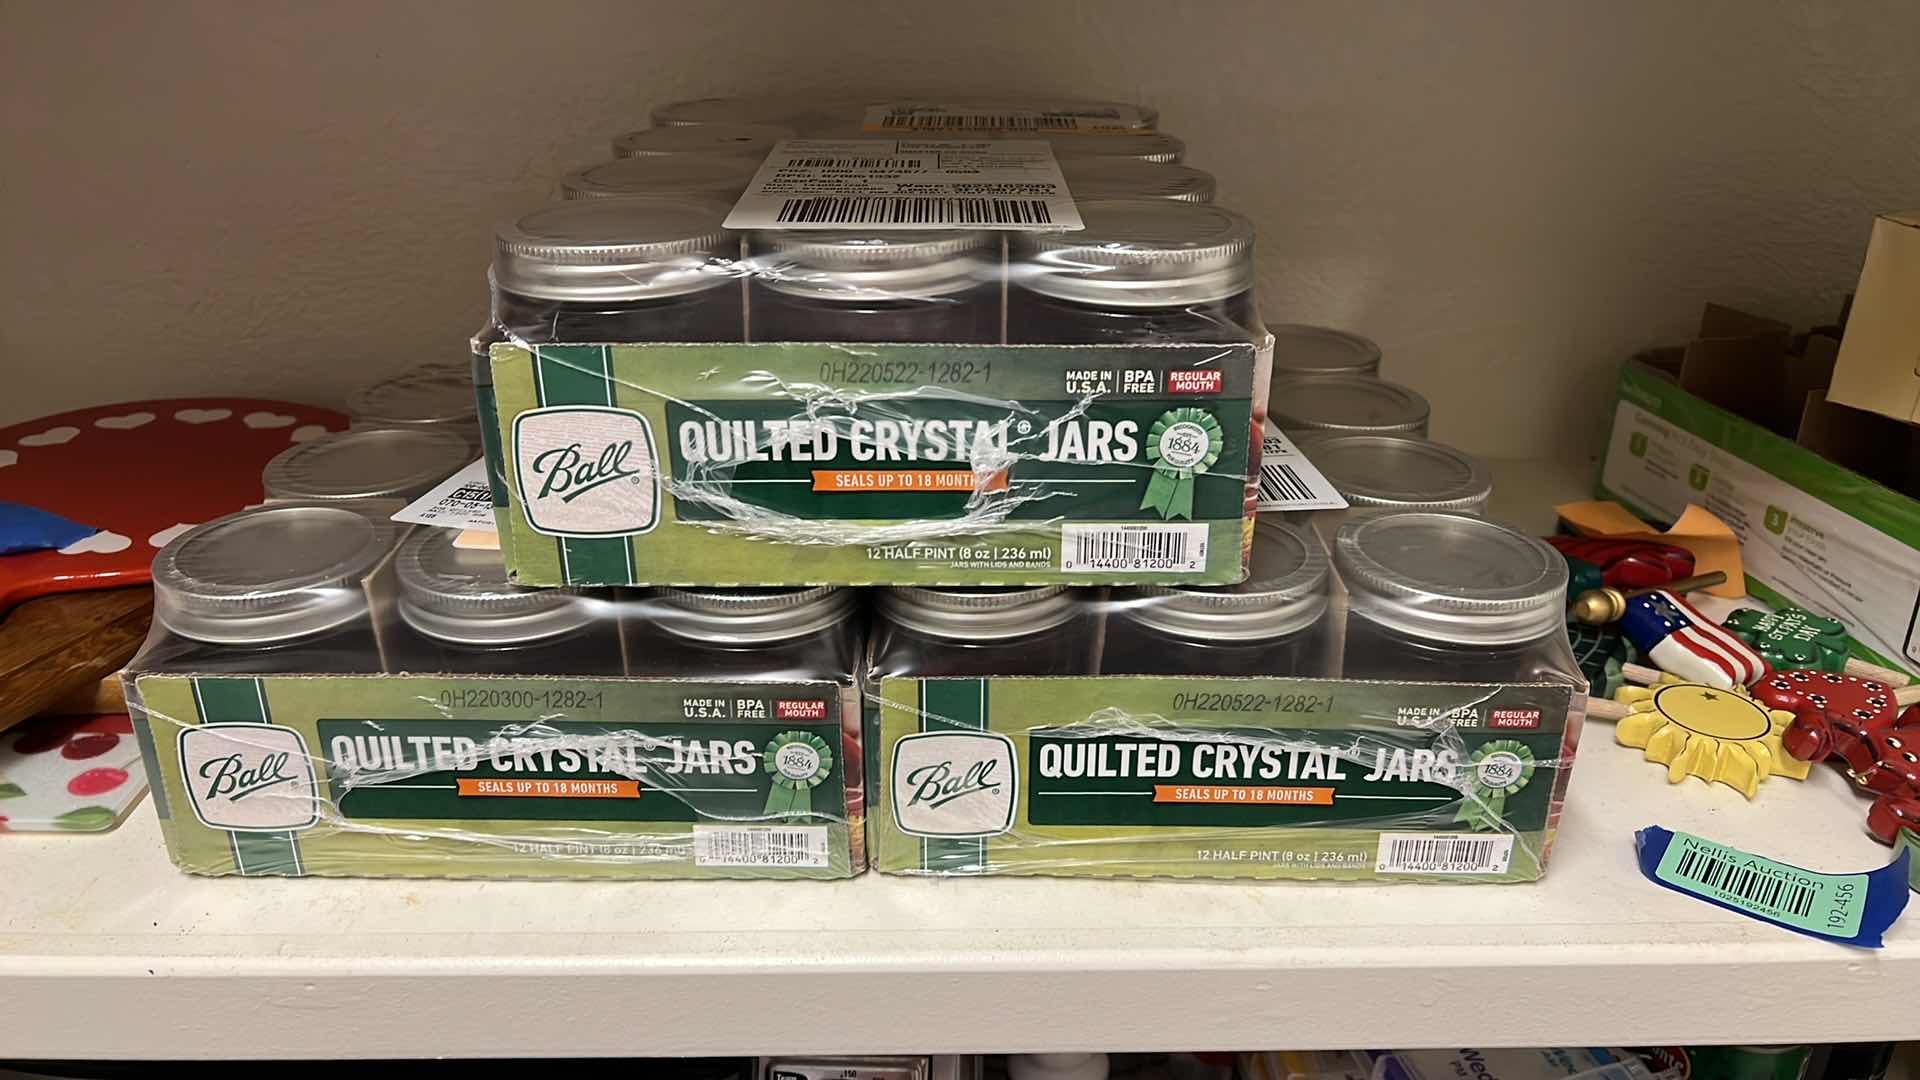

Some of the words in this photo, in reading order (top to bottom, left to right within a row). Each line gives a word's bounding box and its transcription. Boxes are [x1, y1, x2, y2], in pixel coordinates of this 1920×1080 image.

[1066, 371, 1097, 381] MADE
[1101, 371, 1112, 381] IN
[1125, 370, 1155, 383] BPA
[1170, 372, 1221, 382] REGULAR
[1066, 381, 1112, 394] U.S.A.
[1124, 383, 1155, 393] FREE
[1176, 381, 1214, 390] MOUTH
[679, 420, 838, 463] QUILTED
[1039, 420, 1139, 463] JARS
[1168, 437, 1200, 455] 1884
[533, 440, 640, 503] Ball
[836, 474, 874, 487] SEALS
[878, 474, 893, 487] UP
[899, 474, 913, 487] TO
[918, 474, 932, 487] 18
[936, 474, 980, 487] MONTH
[866, 548, 882, 560] 12
[884, 547, 921, 560] HALF
[925, 547, 956, 560] PINT
[958, 547, 972, 561] (8
[974, 550, 990, 560] oz
[1001, 547, 1028, 560] 236
[1030, 547, 1052, 561] ml)
[1066, 561, 1073, 569] 0
[1090, 559, 1128, 569] 14400
[1133, 559, 1173, 569] 81200
[1189, 560, 1196, 569] 2
[1793, 624, 1822, 642] DAY
[683, 699, 712, 707] MADE
[715, 699, 725, 708] IN
[737, 699, 764, 710] BPA
[778, 701, 825, 710] REGULAR
[684, 707, 726, 718] U.S.A.
[737, 709, 766, 718] FREE
[784, 709, 819, 718] MOUTH
[1397, 707, 1425, 716] MADE
[1428, 708, 1441, 717] IN
[1450, 708, 1479, 719] BPA
[1493, 710, 1540, 719] REGULAR
[1450, 718, 1478, 727] FREE
[1498, 718, 1533, 727] MOUTH
[331, 735, 477, 771] QUILTED
[665, 740, 757, 775] JARS
[783, 755, 813, 770] 1884
[1039, 743, 1181, 778] QUILTED
[1363, 748, 1459, 783] JARS
[1484, 763, 1513, 778] 1884
[199, 752, 298, 803] Ball
[478, 781, 513, 793] SEALS
[516, 782, 532, 793] UP
[535, 782, 550, 793] TO
[552, 783, 567, 793] 18
[571, 782, 618, 794] MONTHS
[906, 759, 1001, 809] Ball
[1175, 788, 1211, 800] SEALS
[1214, 788, 1229, 800] UP
[1231, 789, 1246, 800] TO
[1250, 789, 1264, 800] 18
[1267, 789, 1314, 801] MONTHS
[762, 855, 798, 864] 81200
[813, 857, 820, 865] 2
[1197, 850, 1211, 861] 12
[1213, 850, 1247, 861] HALF
[1249, 850, 1279, 861] PINT
[1281, 851, 1293, 862] (8
[1296, 853, 1311, 861] oz
[1322, 851, 1345, 862] 236
[1347, 851, 1368, 862] ml)
[1402, 863, 1438, 871] 14400
[1442, 863, 1478, 871] 81200
[1491, 864, 1500, 872] 2
[1683, 838, 1738, 864] Nellis
[1743, 859, 1824, 890] Auction
[1712, 890, 1781, 918] 1025192456
[1827, 883, 1855, 930] 192-456
